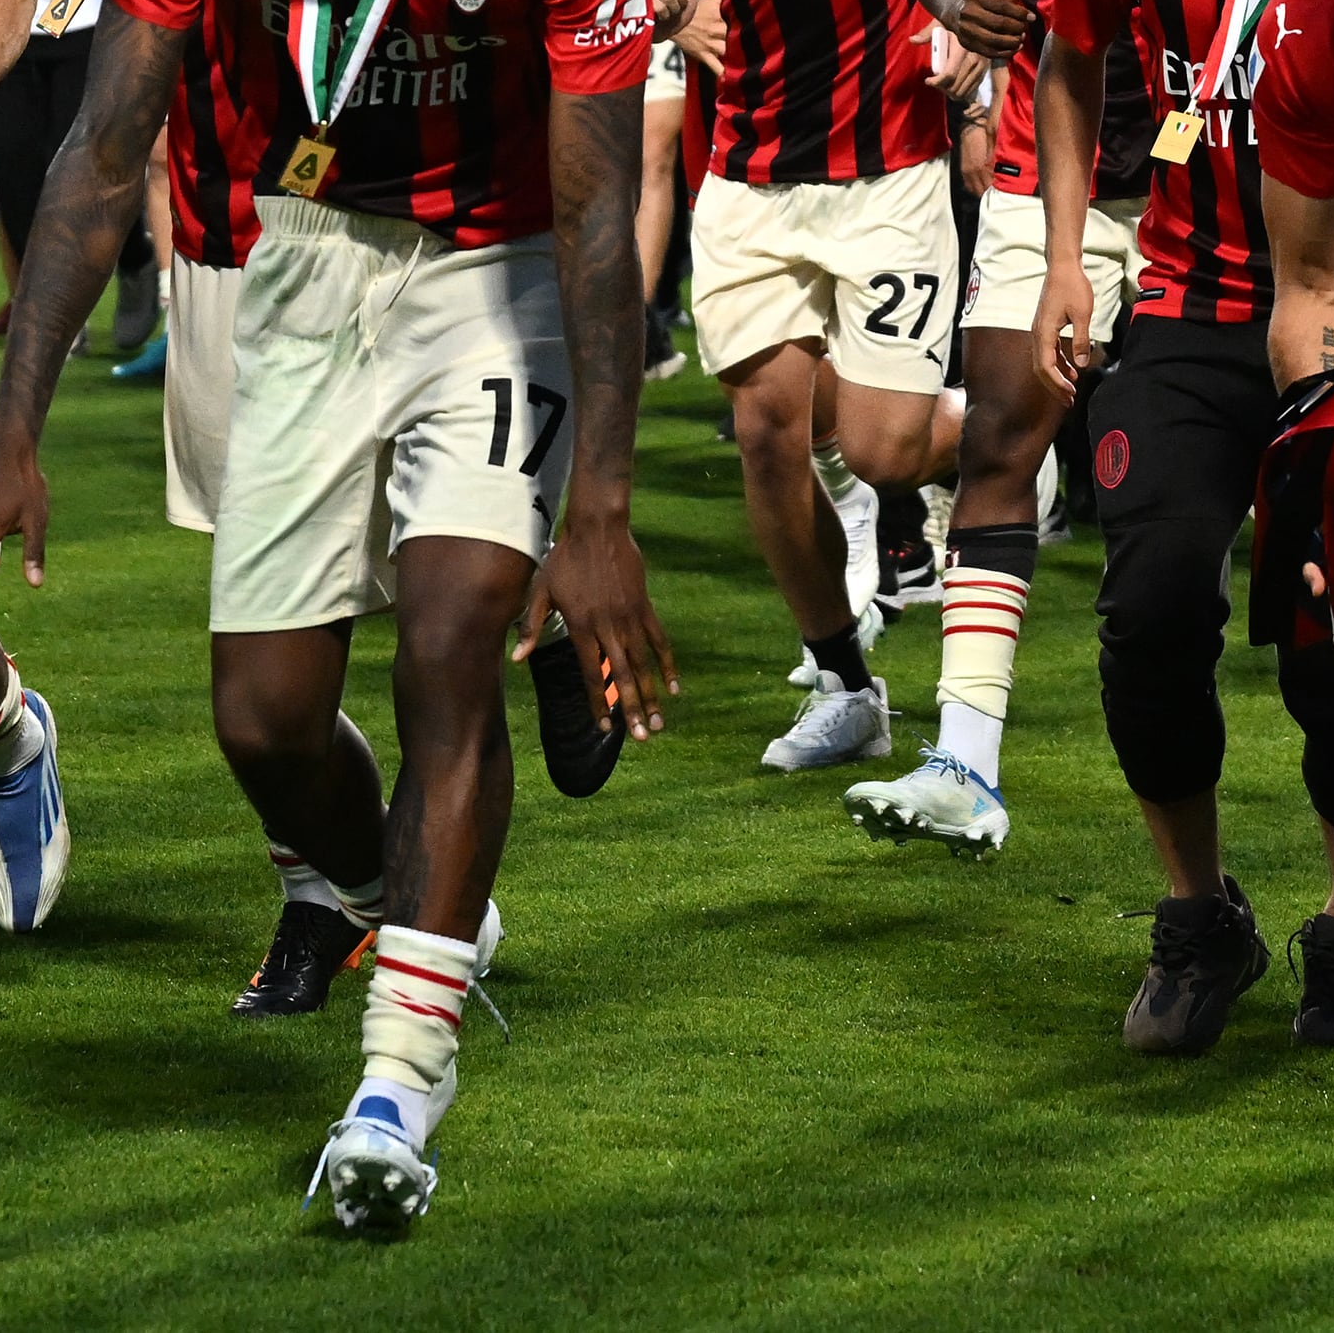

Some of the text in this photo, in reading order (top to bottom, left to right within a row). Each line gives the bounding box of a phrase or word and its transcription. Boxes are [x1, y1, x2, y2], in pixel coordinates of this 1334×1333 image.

[574, 18, 655, 47] BitM
[346, 62, 468, 108] BETTER
[648, 44, 683, 80] 4
[864, 273, 940, 340] 27
[481, 378, 567, 477] 17
